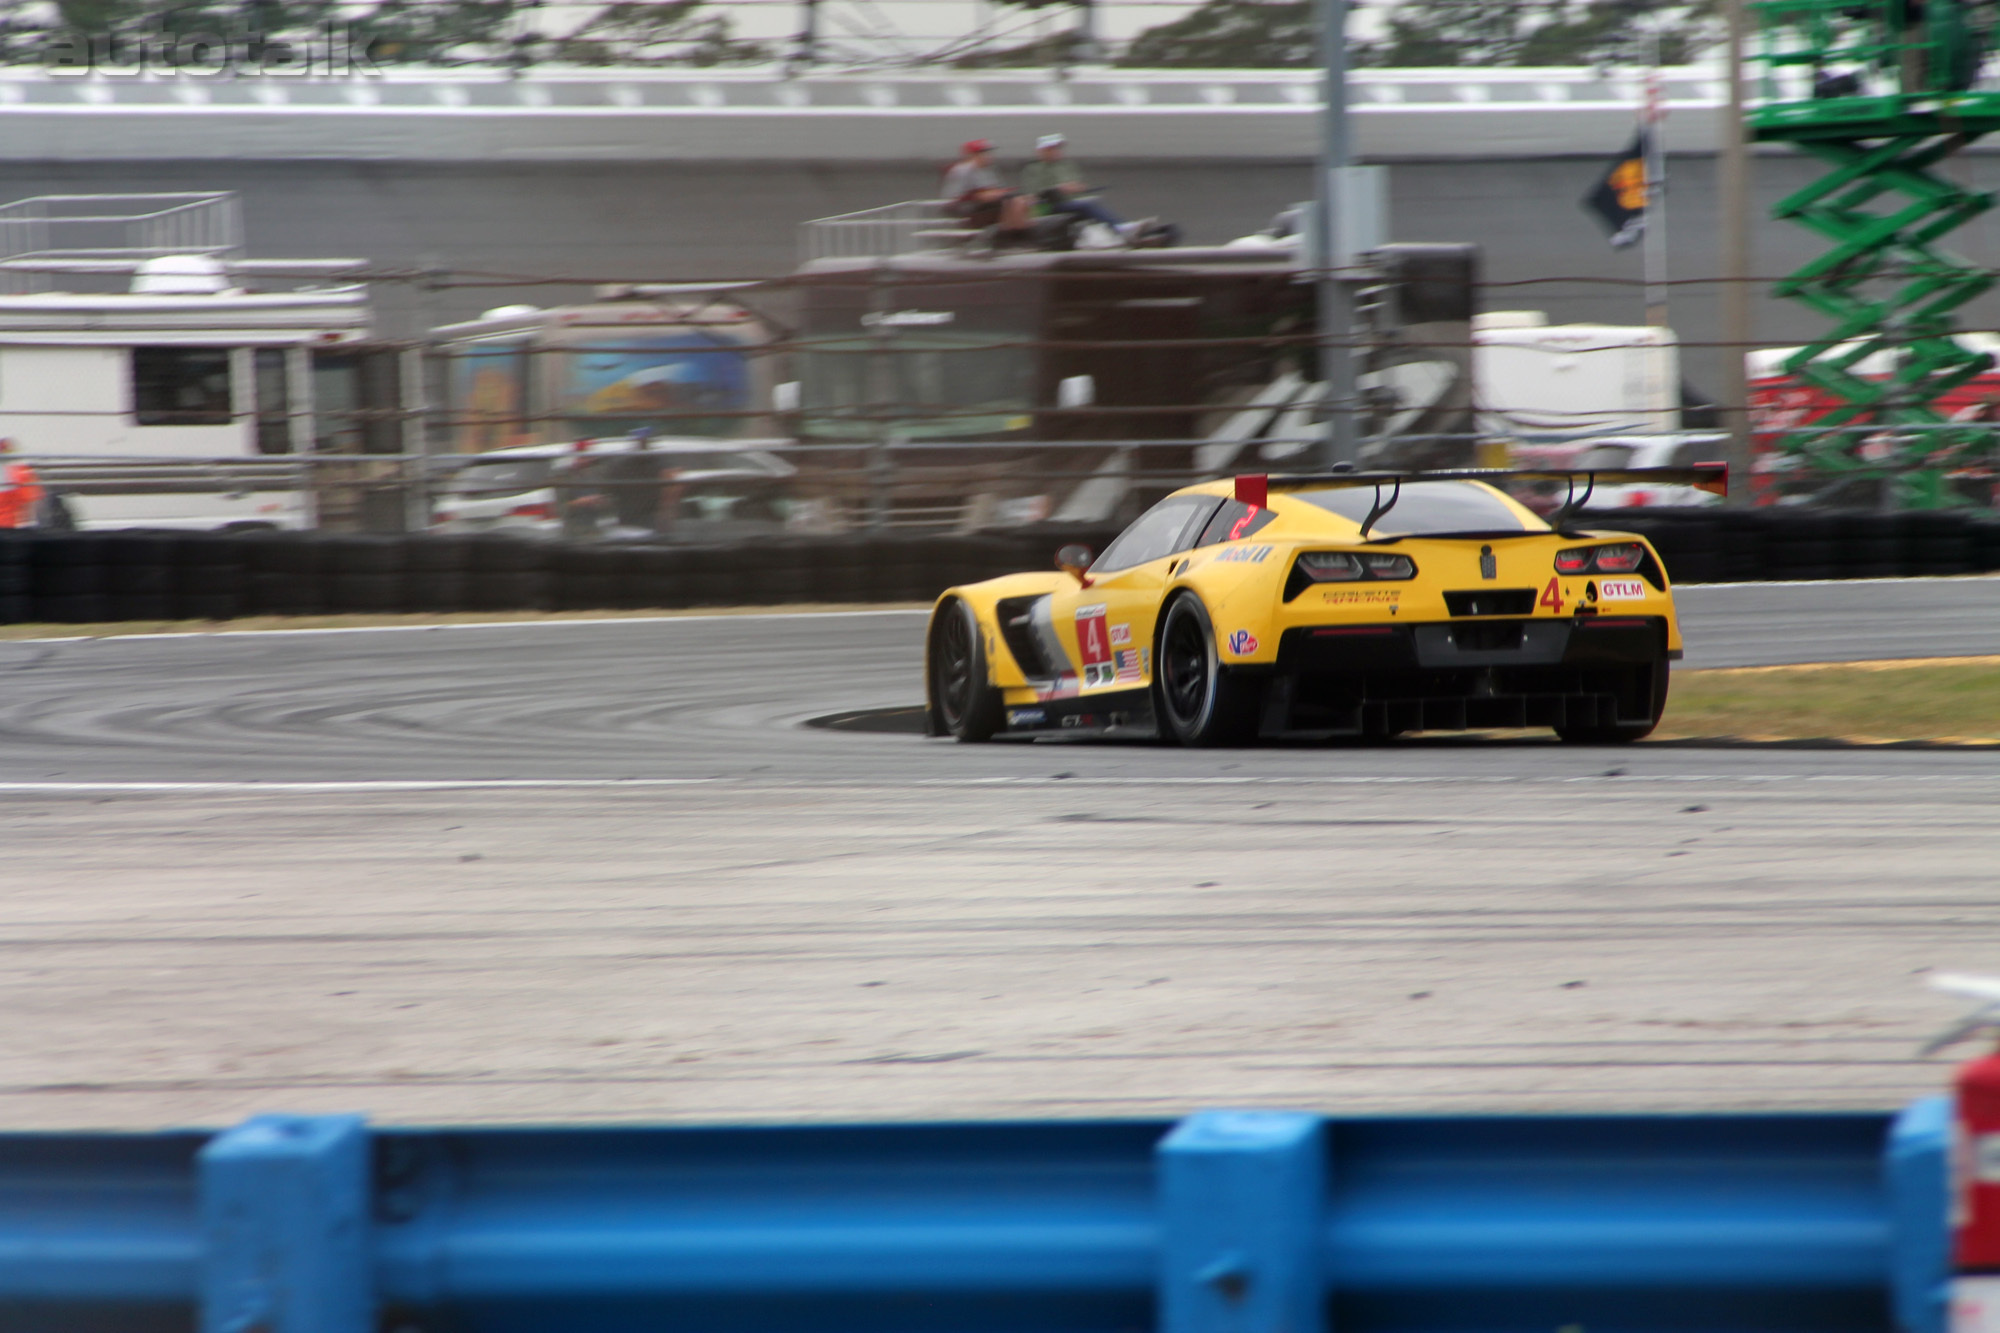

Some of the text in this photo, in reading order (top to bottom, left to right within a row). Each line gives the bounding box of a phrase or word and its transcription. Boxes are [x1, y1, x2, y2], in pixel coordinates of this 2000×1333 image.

[1540, 577, 1565, 615] 4
[1603, 583, 1643, 596] GTLM
[1087, 617, 1103, 661] 4
[1229, 630, 1249, 654] VP
